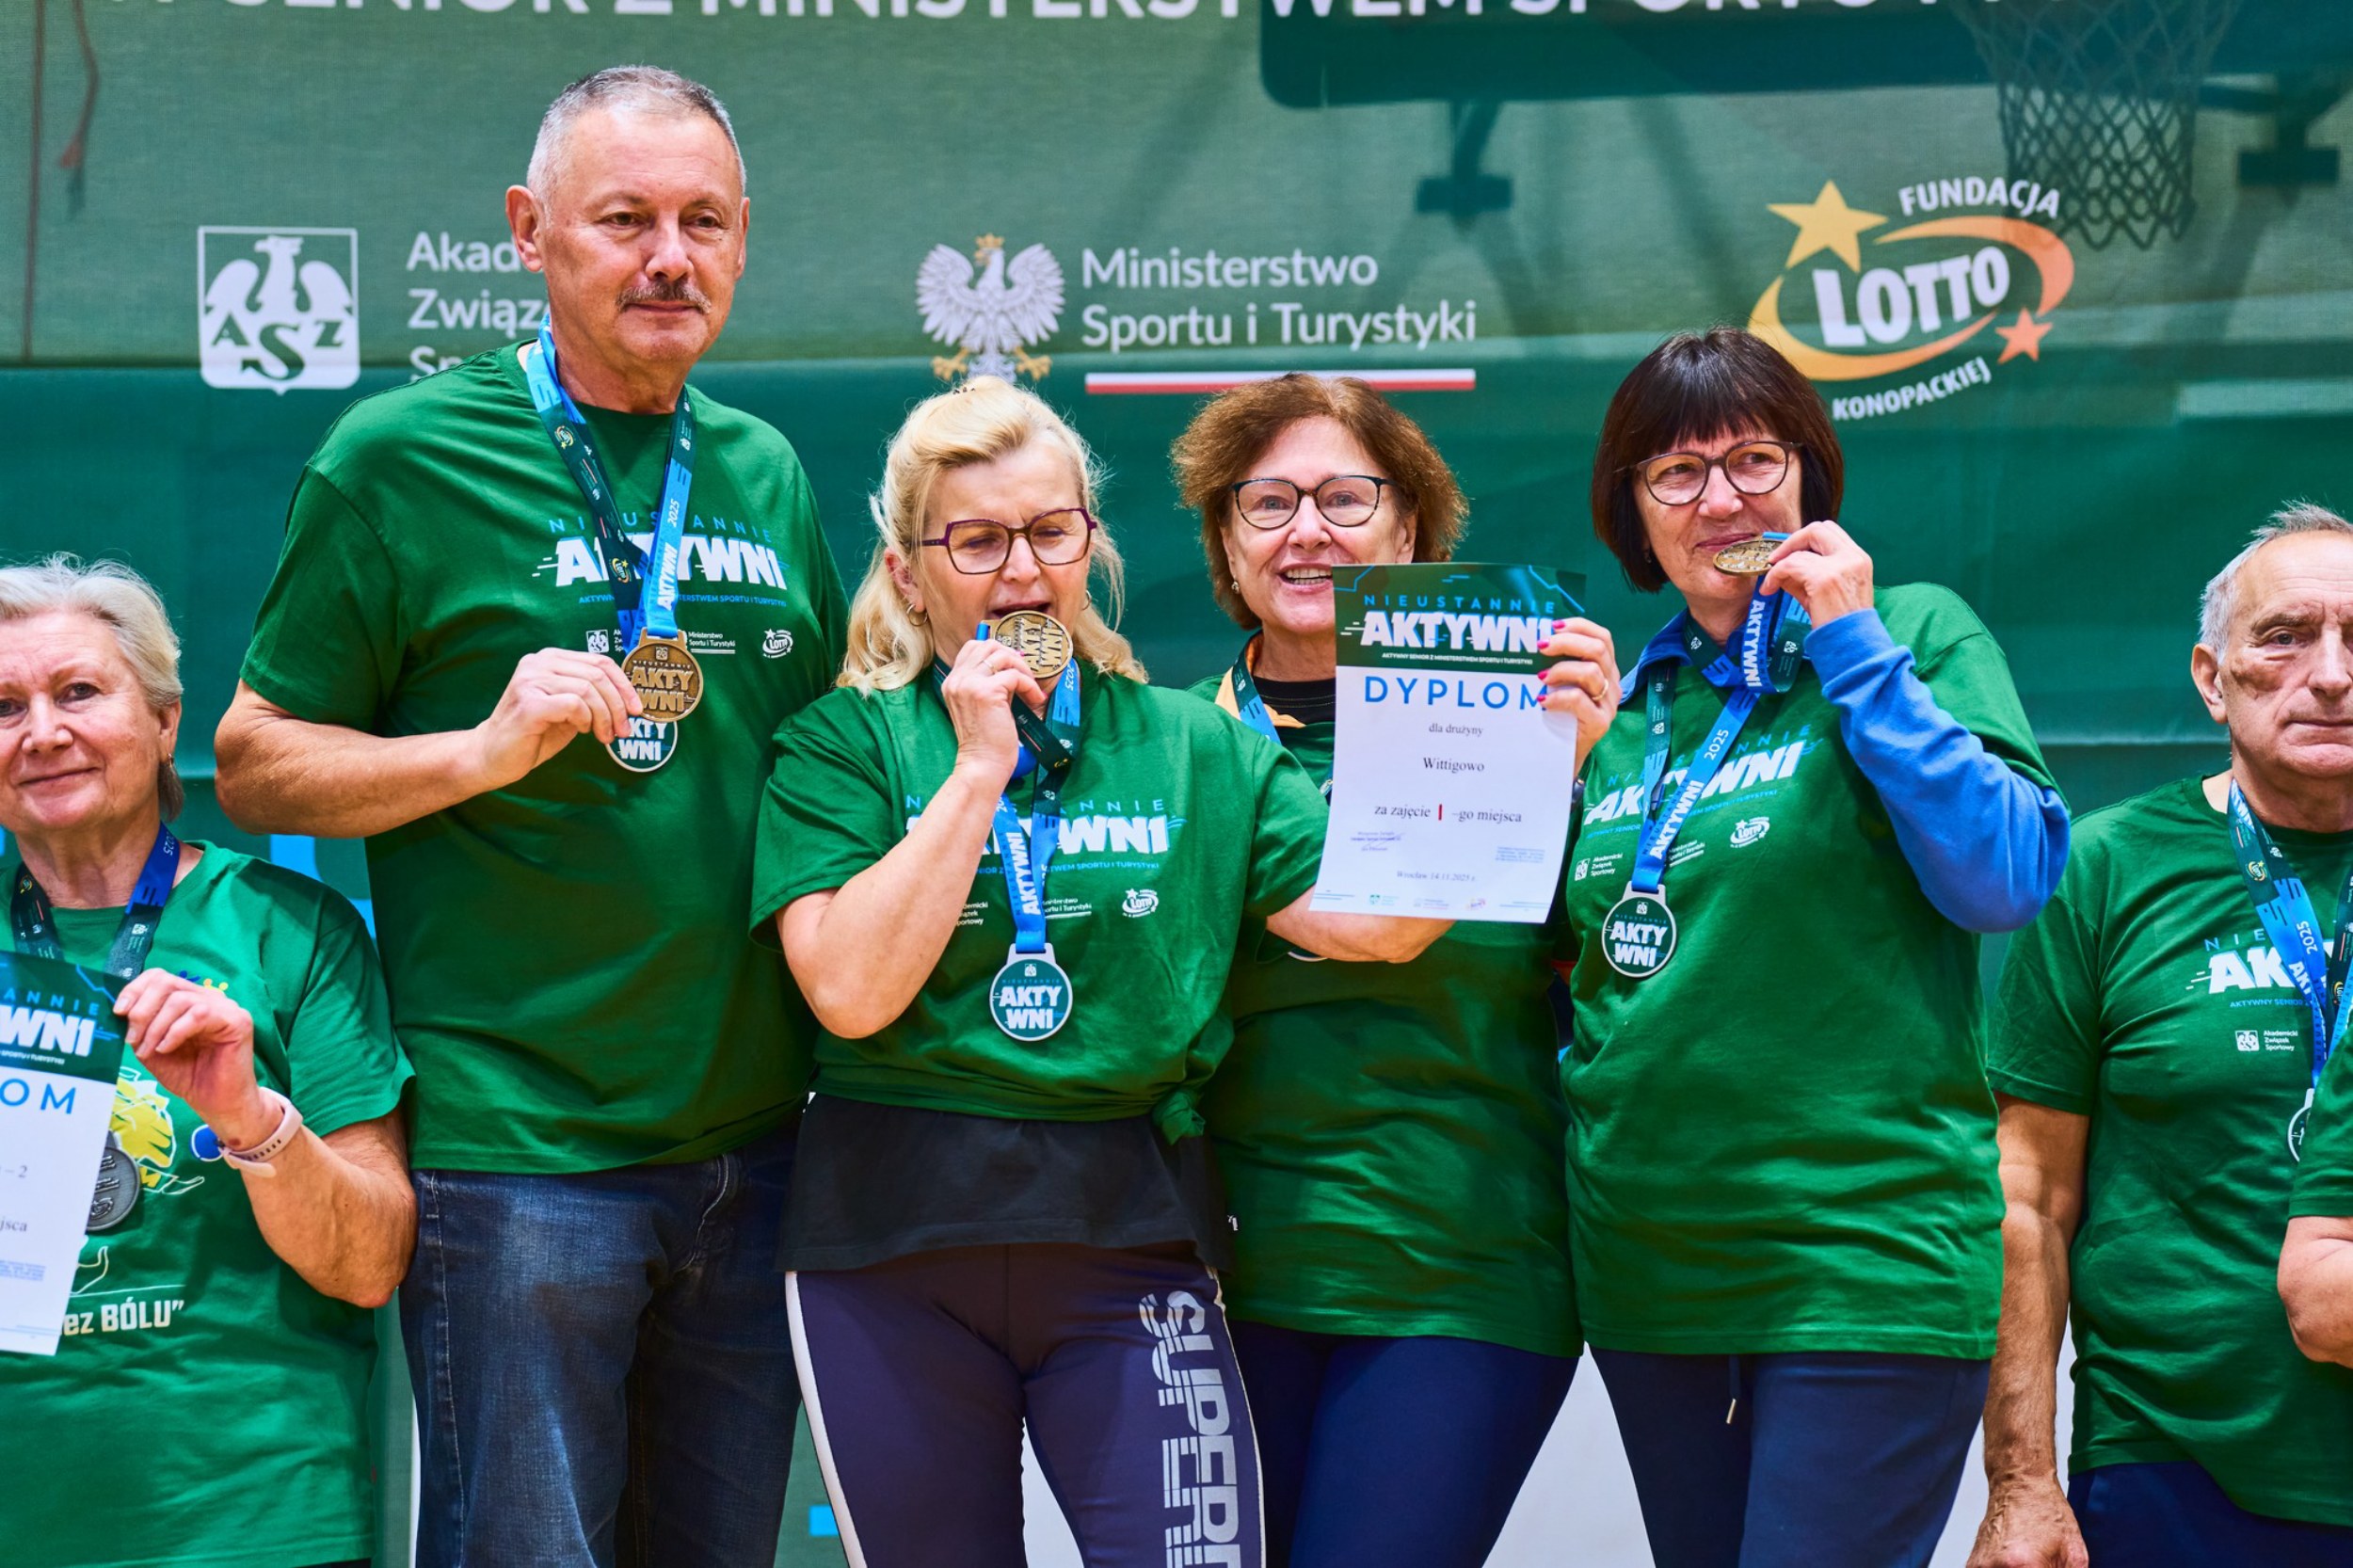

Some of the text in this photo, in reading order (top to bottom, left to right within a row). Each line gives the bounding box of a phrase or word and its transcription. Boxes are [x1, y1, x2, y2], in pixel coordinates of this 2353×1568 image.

[1899, 177, 2060, 218] FUNDACJA
[1083, 247, 1379, 287] Ministerstwo
[1813, 247, 2010, 348] LOTTO
[408, 289, 550, 338] Związ
[1083, 299, 1476, 353] Sportu i Turystyki
[1833, 356, 1992, 422] KONOPACKIEJ
[667, 499, 680, 527] 2025
[549, 511, 772, 544] NIUSANNIE
[657, 542, 678, 611] AKTYWNI
[579, 594, 615, 604] AKTYWN
[1364, 594, 1556, 614] NIEUSTANNIE
[1743, 599, 1766, 687] AKTYWNI
[631, 666, 694, 691] AKTY
[636, 688, 685, 712] WNI
[1365, 676, 1548, 711] DYPLOM
[629, 718, 667, 740] KTY
[1429, 723, 1483, 737] dla drużyny
[618, 739, 662, 761] WNI
[1704, 728, 1729, 760] 2025
[1423, 757, 1484, 774] Wittigowo
[1374, 805, 1387, 816] za
[1390, 804, 1431, 819] zajęcie
[1477, 809, 1522, 824] miejsca
[1649, 780, 1705, 860] AKTYWNI
[976, 866, 996, 874] NIOR
[1077, 862, 1111, 871] SPORTU
[1116, 861, 1160, 870] TURYSTYKI
[1006, 832, 1041, 916] AKTYWNI
[956, 918, 984, 926] portowy
[1609, 920, 1669, 947] AKTY
[2297, 920, 2318, 954] 2025
[1615, 942, 1657, 968] WNI
[999, 985, 1063, 1007] AKTY
[2230, 999, 2271, 1008] AKTYWNY
[1005, 1008, 1053, 1030] WNI
[19, 1165, 27, 1177] 2
[0, 1215, 27, 1232] jsca
[62, 1311, 94, 1336] ez
[1139, 1290, 1242, 1568] SUPER
